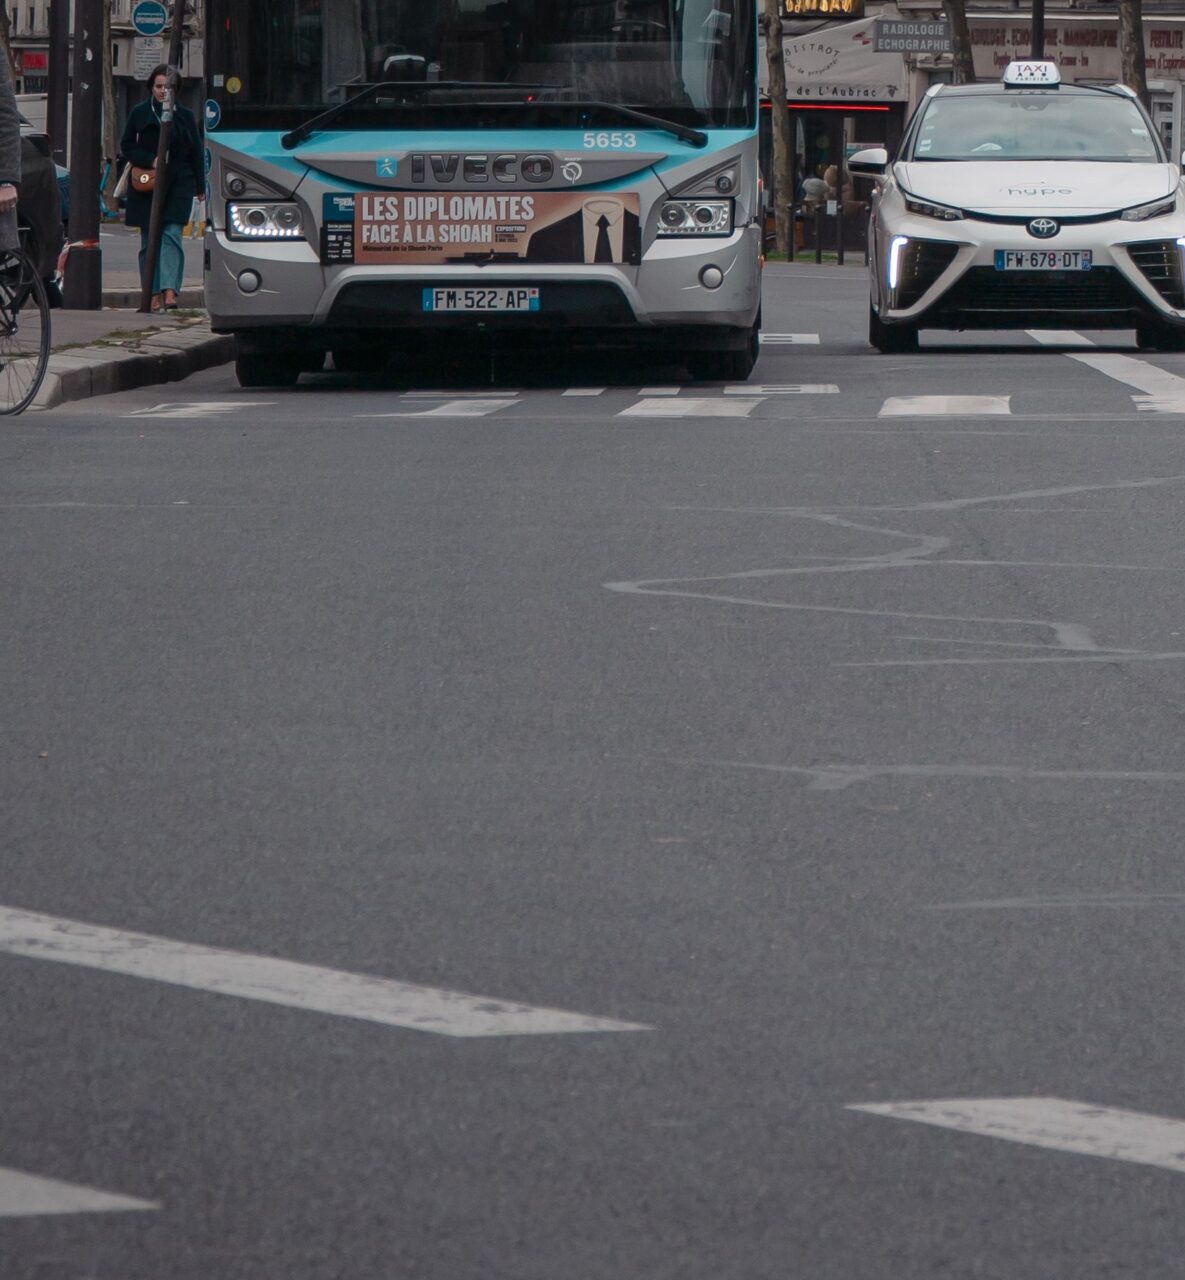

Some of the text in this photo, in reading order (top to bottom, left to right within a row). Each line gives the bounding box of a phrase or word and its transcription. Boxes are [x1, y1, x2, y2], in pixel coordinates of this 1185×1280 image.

[882, 23, 945, 36] RADIOLOGIE
[784, 43, 840, 58] BISTROT
[878, 38, 950, 51] ECHOGRAPHIE
[1016, 64, 1047, 72] TAXI
[797, 86, 810, 96] de
[819, 86, 877, 97] L'Aubrac
[583, 133, 637, 148] 5653
[411, 154, 554, 183] IVECO
[1008, 188, 1072, 198] hype
[362, 196, 399, 221] LES
[403, 196, 534, 221] DIPLOMATES
[362, 224, 400, 244] FACE
[403, 221, 413, 243] À
[416, 224, 435, 243] LA
[439, 224, 492, 243] SHOAH
[1007, 252, 1080, 267] FW-678-DT
[435, 290, 527, 308] FM-522-AP
